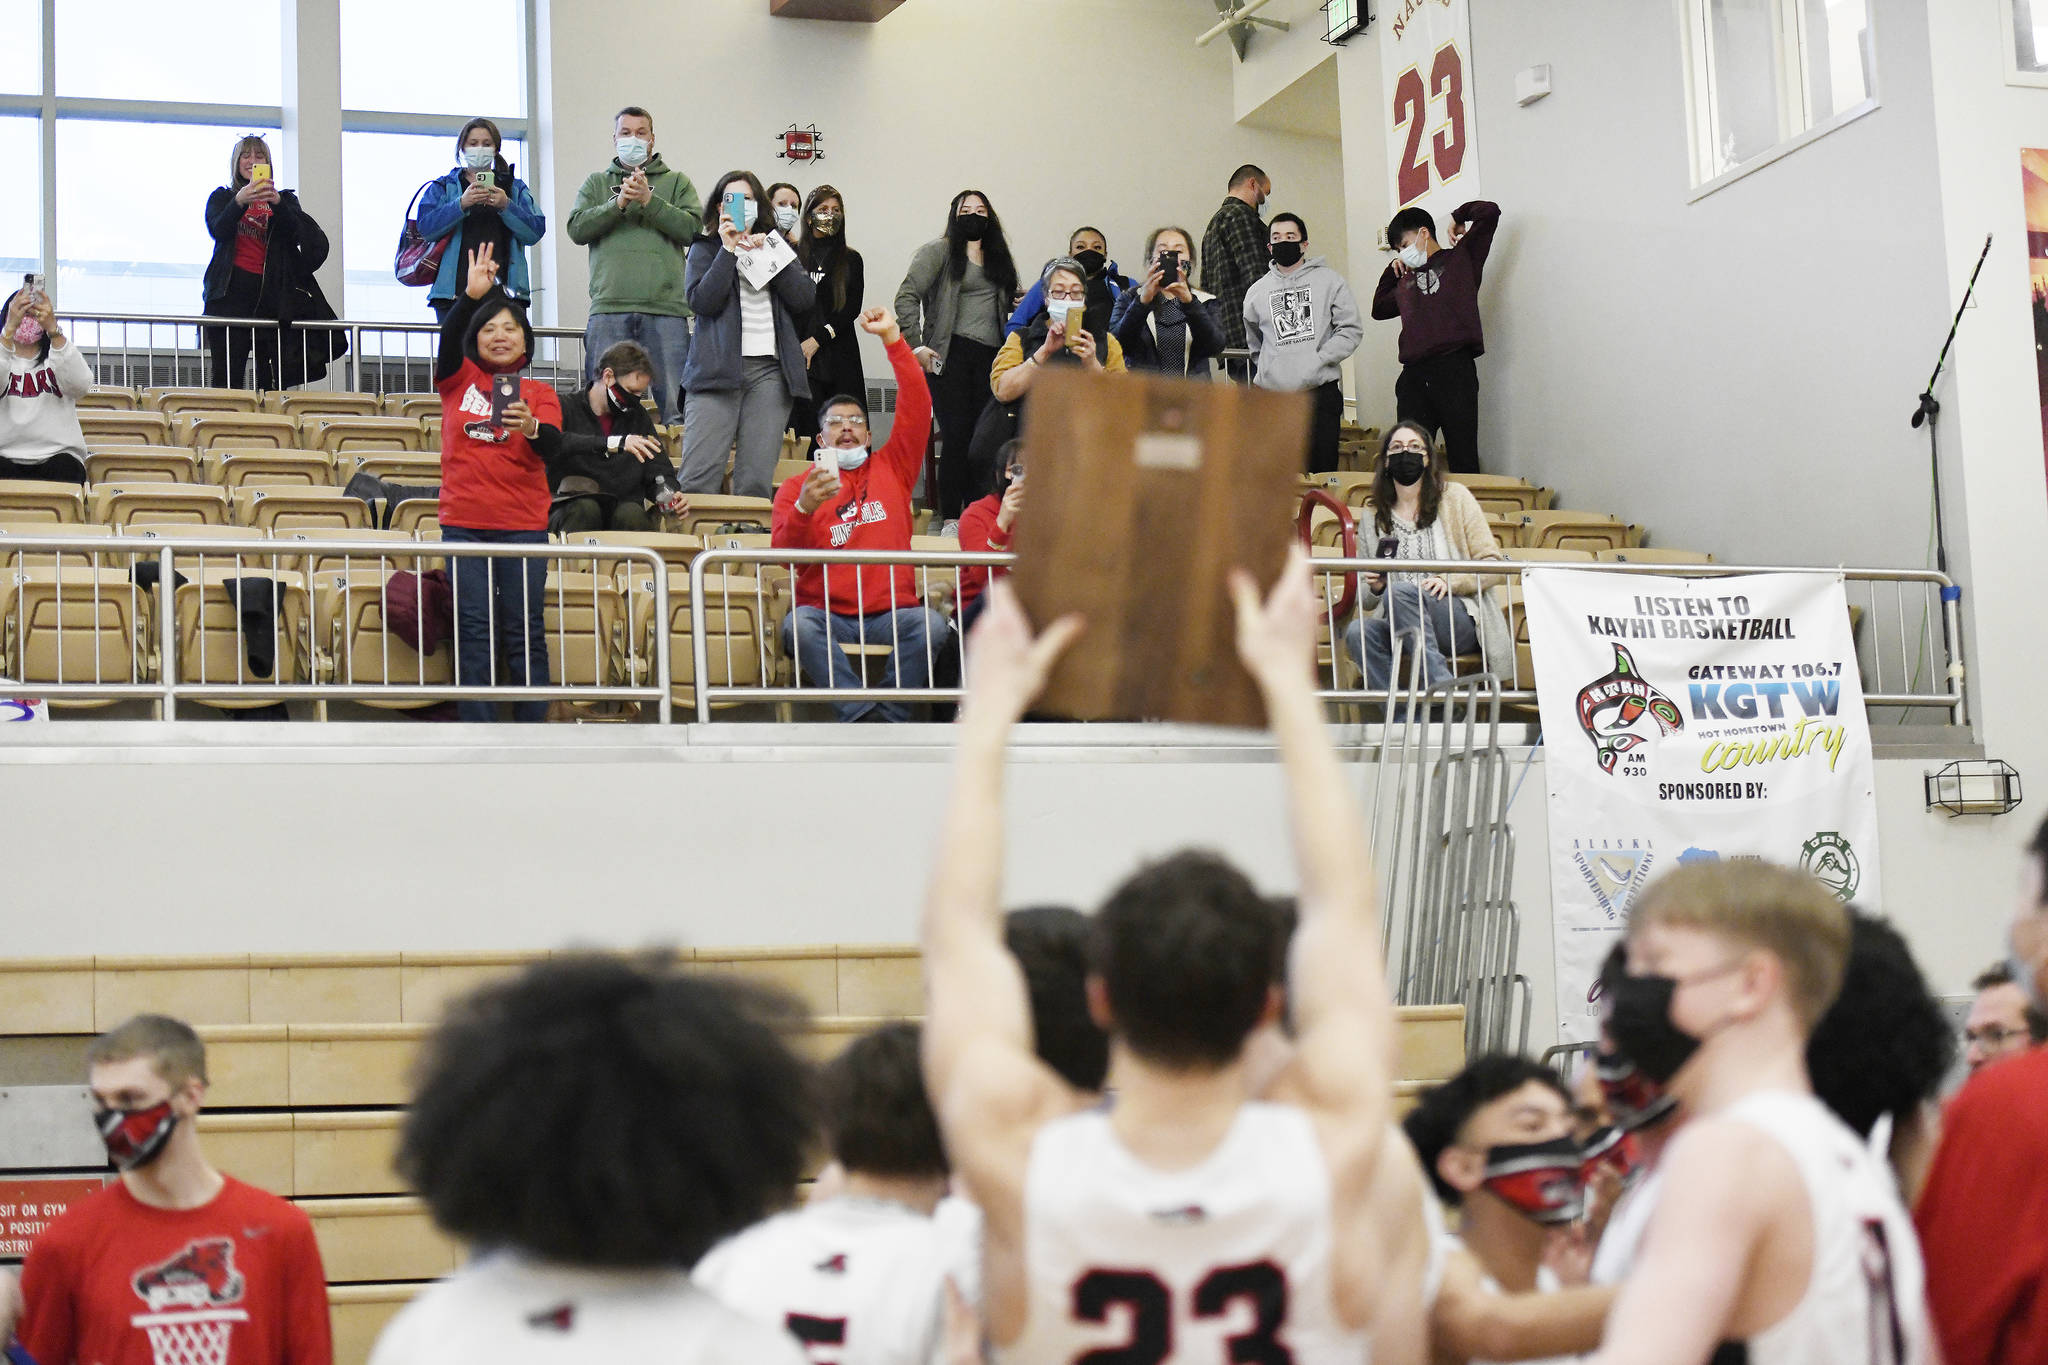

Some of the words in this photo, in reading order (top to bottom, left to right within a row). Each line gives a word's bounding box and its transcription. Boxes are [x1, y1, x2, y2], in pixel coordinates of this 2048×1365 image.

[1392, 38, 1467, 210] 23
[1633, 595, 1713, 617] LISTEN
[1717, 595, 1750, 616] TO
[1587, 614, 1657, 638] KAYHI
[1661, 618, 1797, 640] BASKETBALL
[1688, 664, 1786, 680] GATEWAY
[1791, 662, 1843, 678] 106.7
[1687, 680, 1841, 721] KGTW
[1698, 729, 1722, 739] HOT
[1724, 723, 1787, 738] HOMETOWN
[1701, 716, 1848, 773] country
[1627, 753, 1646, 763] AM
[1623, 767, 1648, 777] 930
[1659, 783, 1741, 801] SPONSORED
[1746, 782, 1767, 800] BY:
[1573, 838, 1654, 849] ALASKA
[0, 1204, 17, 1217] SIT
[21, 1204, 38, 1217] ON
[43, 1203, 67, 1217] GYM
[1070, 1257, 1292, 1365] 23
